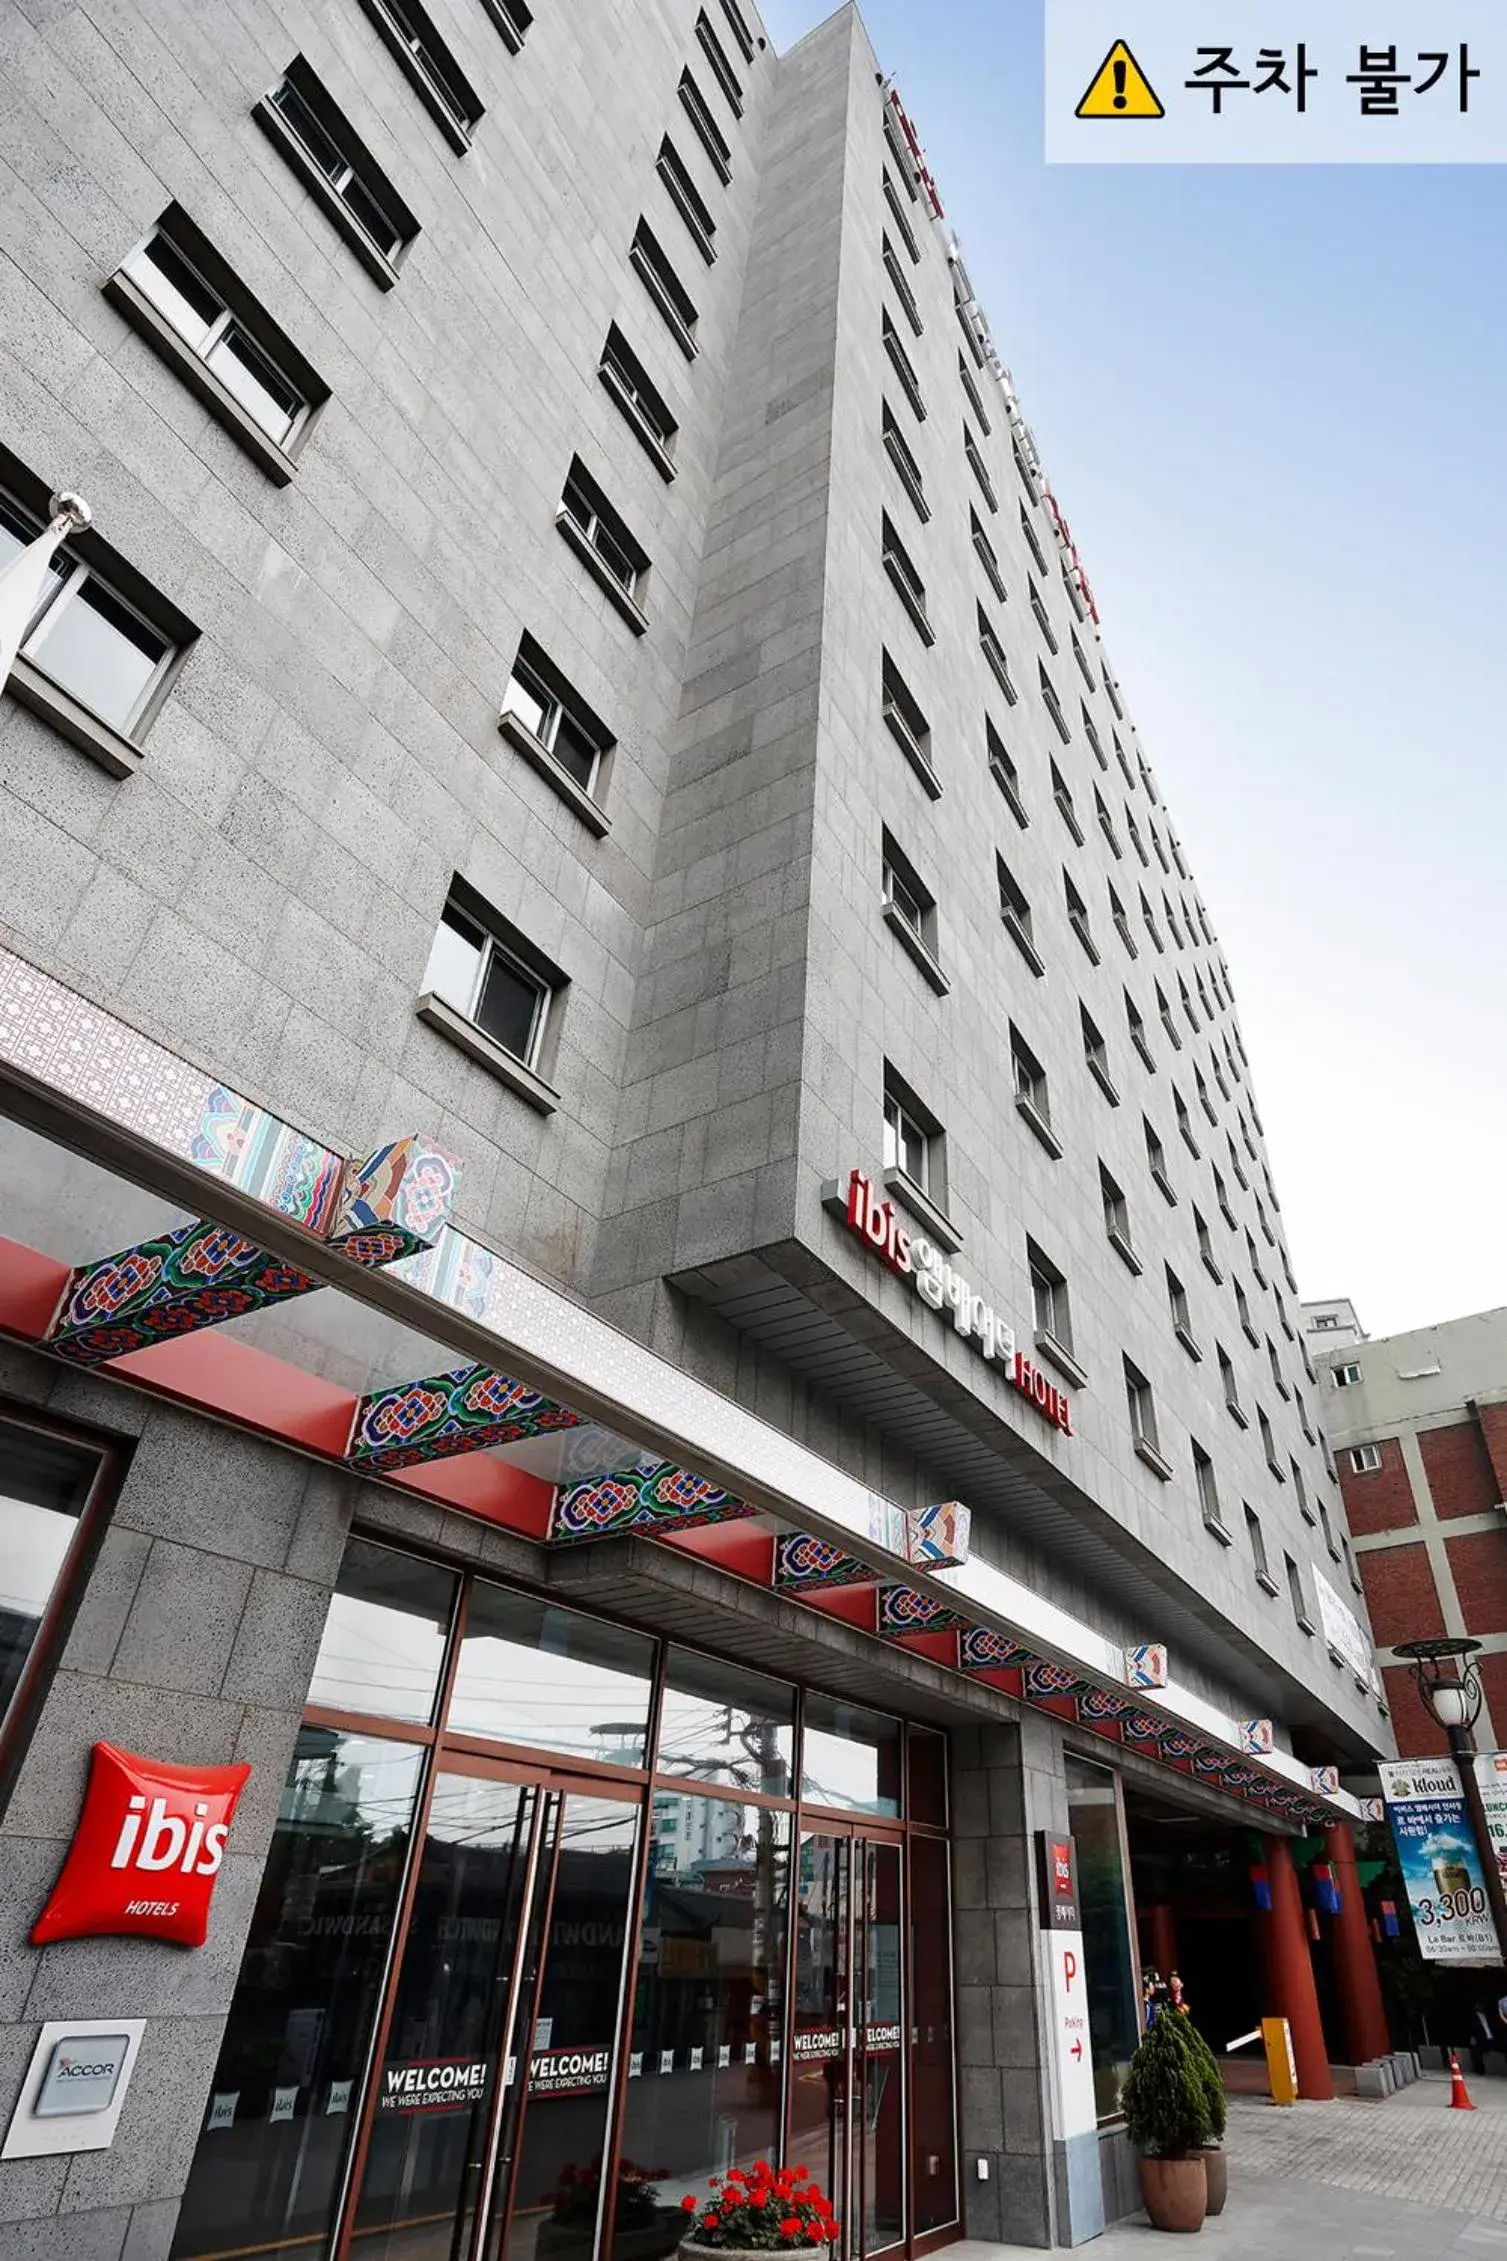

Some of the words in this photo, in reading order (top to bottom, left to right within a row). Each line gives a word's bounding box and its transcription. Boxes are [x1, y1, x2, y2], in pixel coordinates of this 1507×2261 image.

[847, 1168, 911, 1275] ibis
[110, 1795, 229, 1876] ibis
[125, 1899, 181, 1917] HOTELS
[1417, 1886, 1486, 1928] 3,300
[1063, 1951, 1077, 1993] P
[793, 2032, 839, 2050] WELCOME!
[866, 2026, 900, 2043] ELCOME!
[57, 2063, 115, 2079] ACCOR
[387, 2064, 487, 2093] WELCOME!
[382, 2095, 396, 2108] WE
[397, 2093, 421, 2107] WERE
[421, 2088, 467, 2105] EXPECTING
[467, 2087, 485, 2100] YOU
